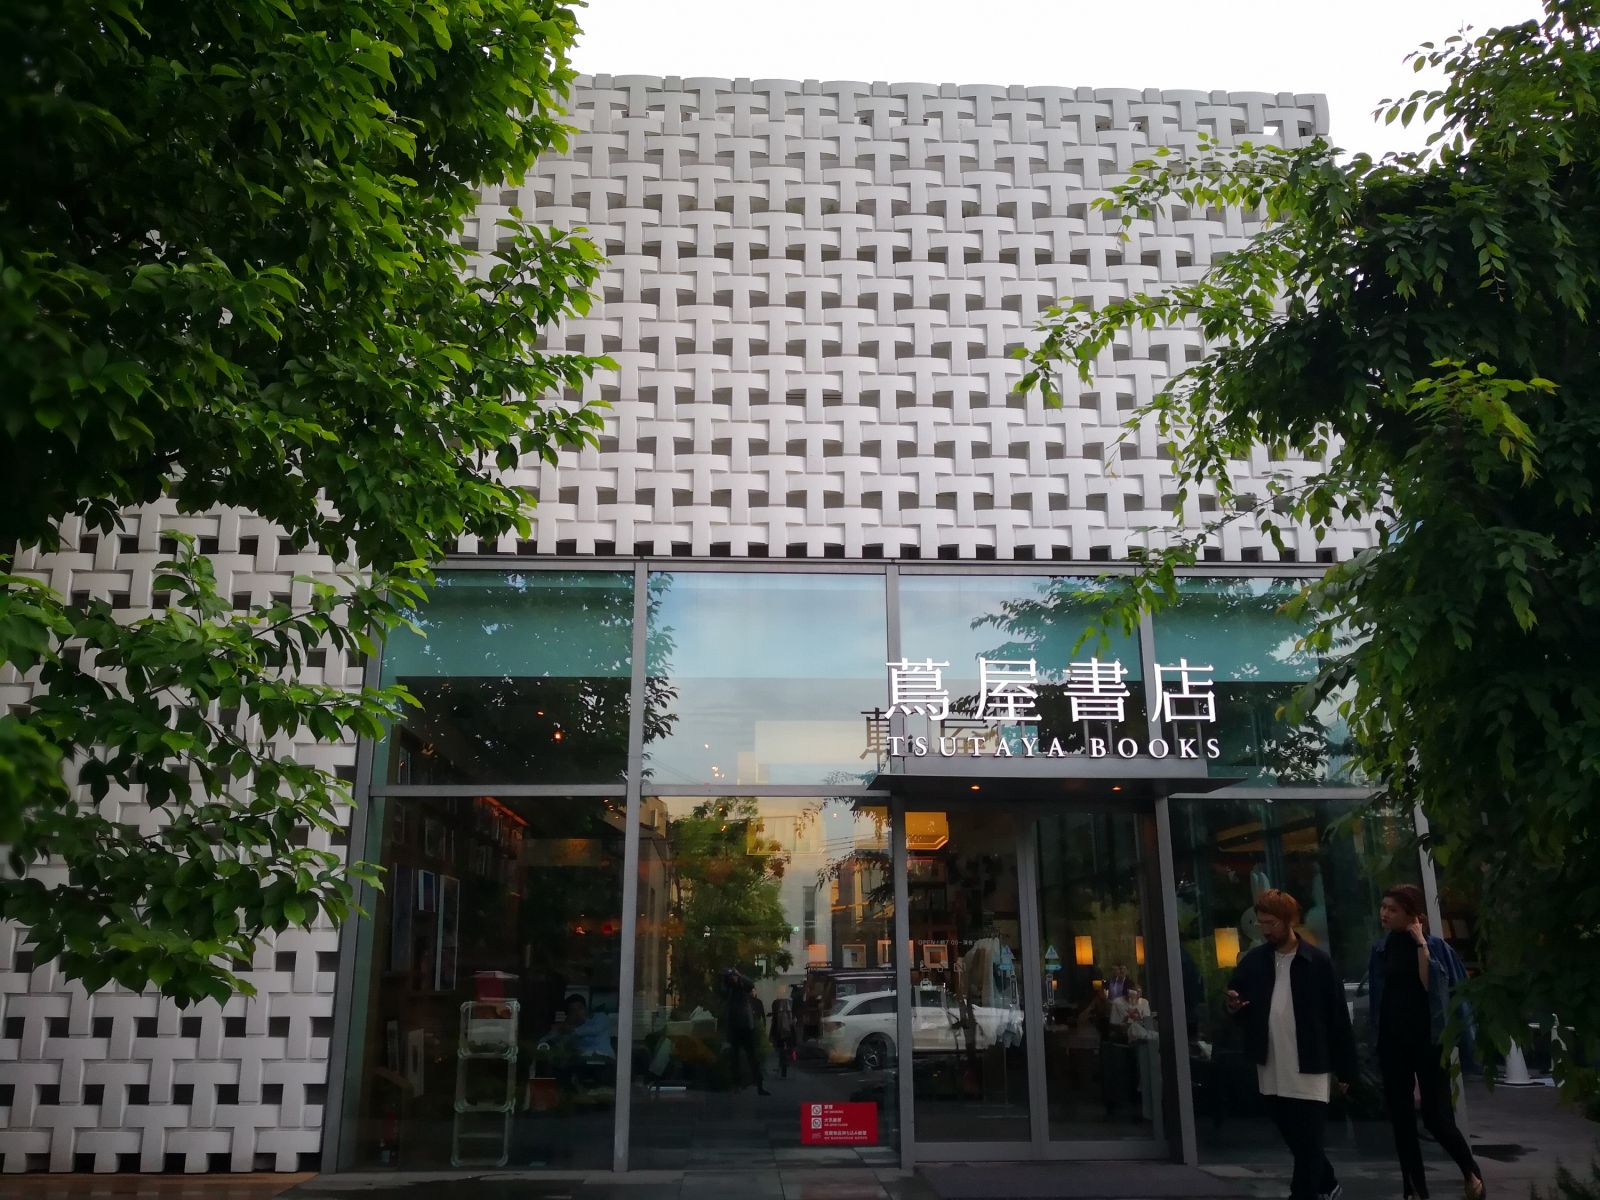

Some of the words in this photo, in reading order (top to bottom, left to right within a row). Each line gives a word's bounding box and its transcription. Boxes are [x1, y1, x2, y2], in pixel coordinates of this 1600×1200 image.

[884, 657, 1216, 722] 蔦屋書店
[886, 736, 1067, 758] TSUTAYA
[1089, 737, 1221, 759] BOOKS
